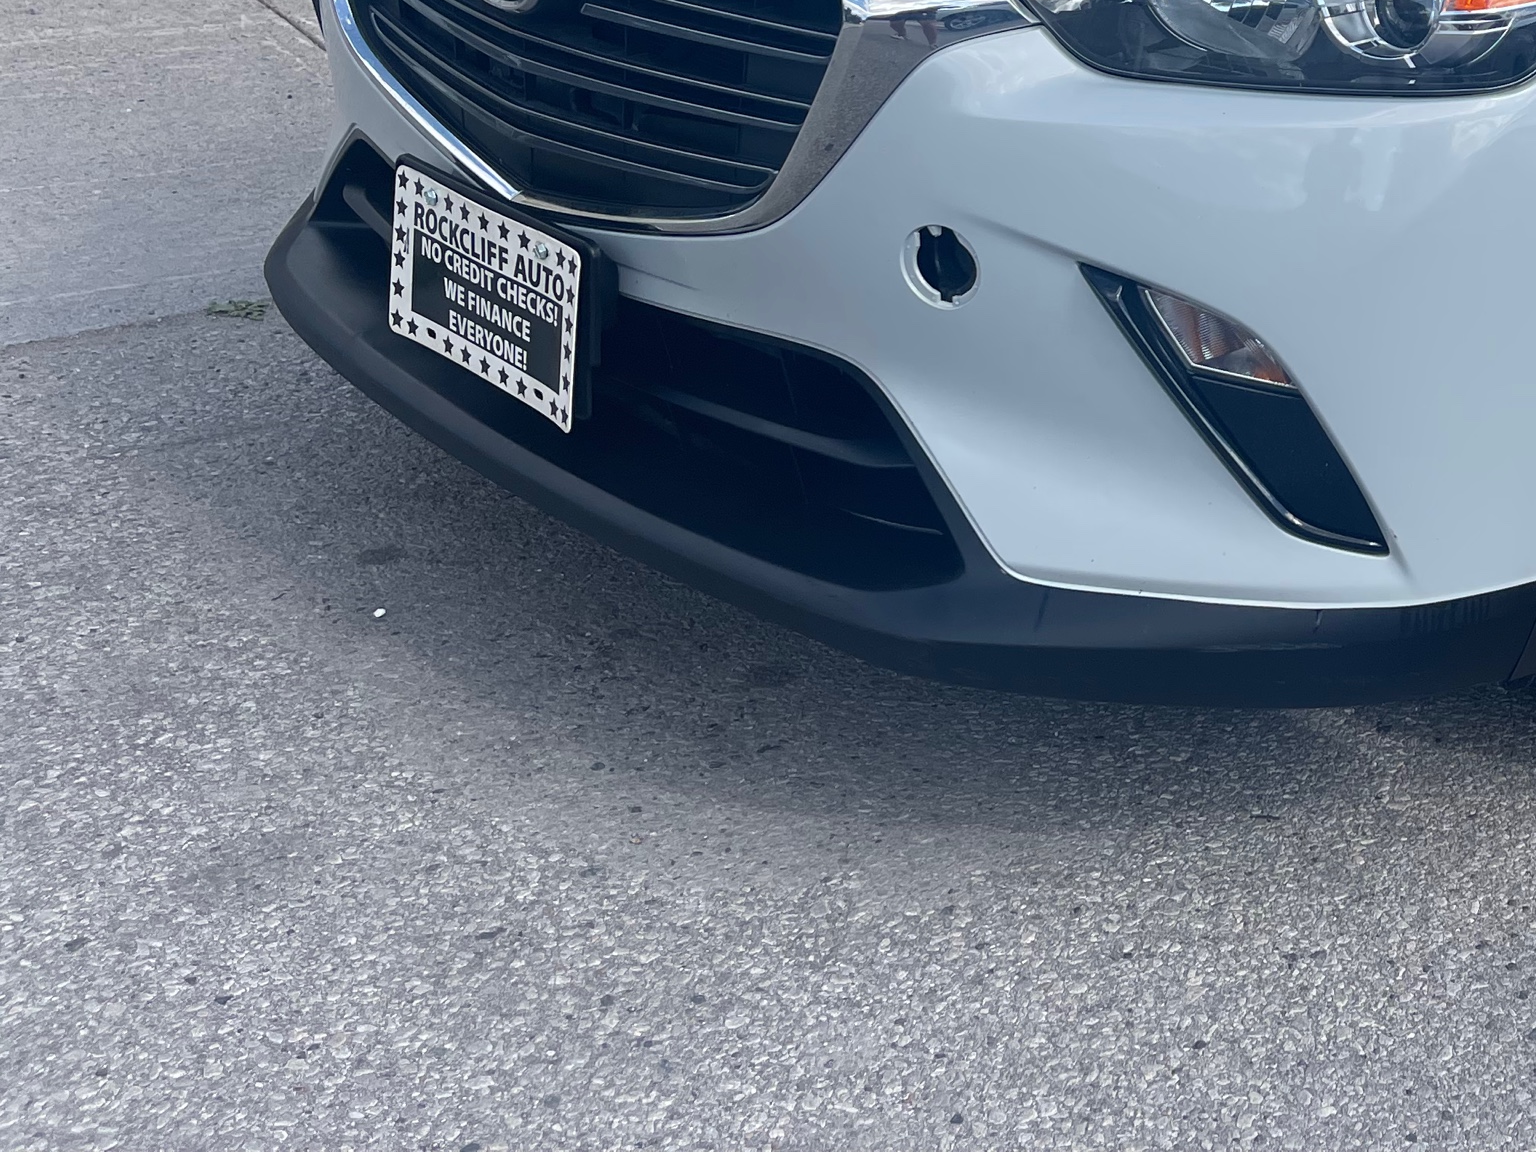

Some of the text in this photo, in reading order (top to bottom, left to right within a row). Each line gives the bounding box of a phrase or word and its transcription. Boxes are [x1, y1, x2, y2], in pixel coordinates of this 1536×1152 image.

[413, 201, 565, 302] ROCKCLIFF AUTO
[421, 236, 559, 327] NO CREDIT CHECKS!
[443, 276, 531, 343] WE FINANCE
[448, 309, 528, 371] EVERYONE!
